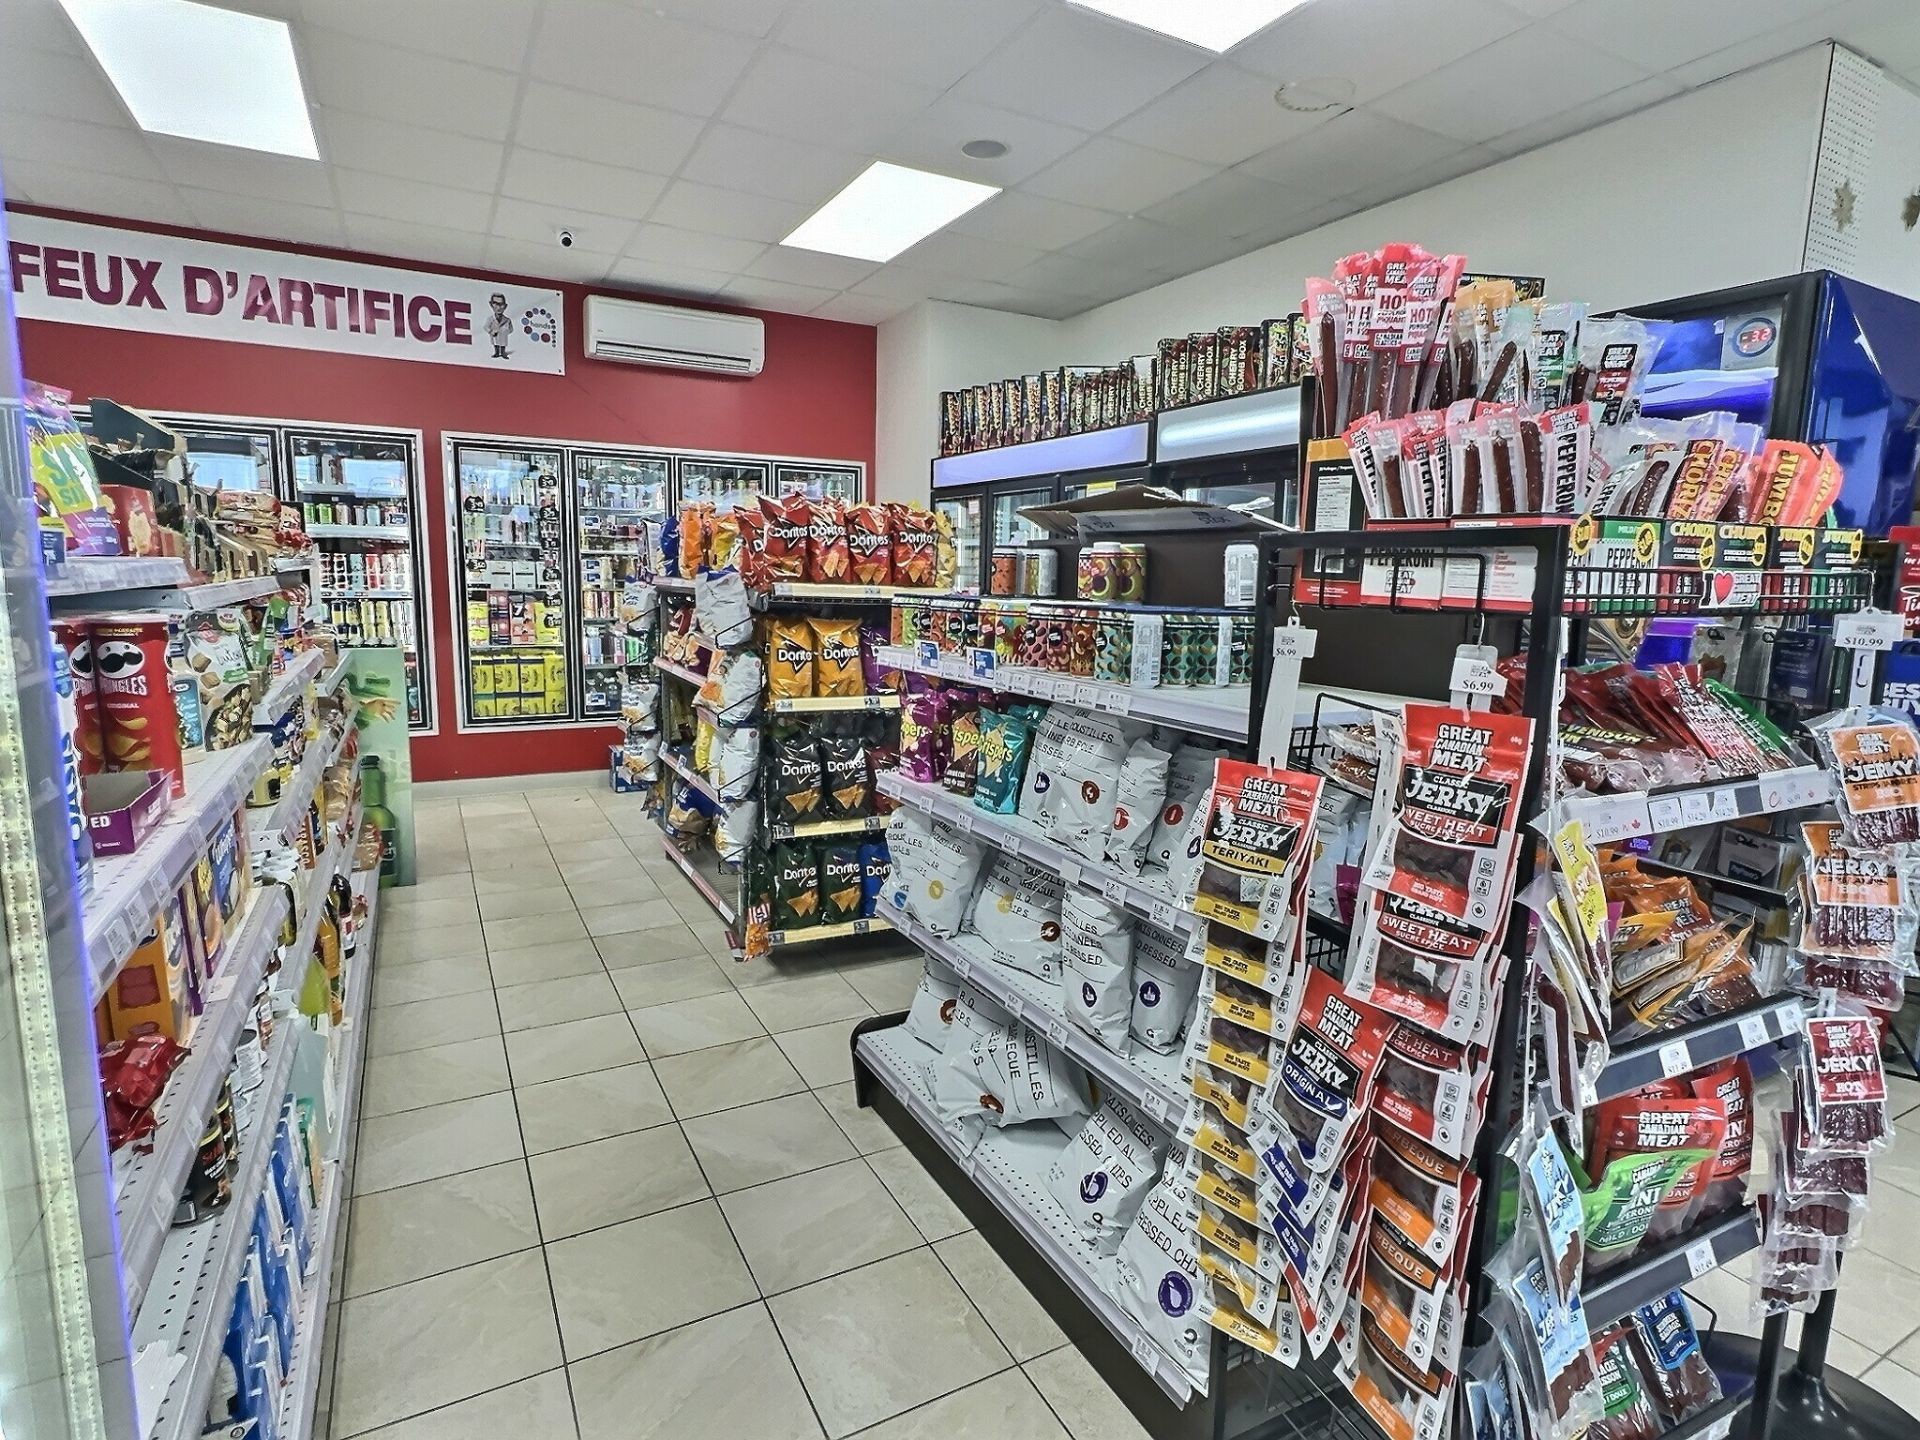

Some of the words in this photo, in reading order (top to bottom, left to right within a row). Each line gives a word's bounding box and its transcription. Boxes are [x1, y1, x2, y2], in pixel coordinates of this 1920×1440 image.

[9, 240, 167, 311] FEUX
[182, 264, 473, 345] D'ARTIFICE
[530, 320, 551, 330] hands
[1410, 308, 1434, 324] HOT
[1205, 345, 1214, 369] BOX
[1238, 339, 1247, 362] BOX
[1170, 359, 1179, 395] CHERRY
[1196, 353, 1205, 390] CHERRY
[1229, 348, 1237, 386] CHERRY
[1236, 362, 1246, 391] BOMB
[1177, 372, 1187, 400] BOMB
[1204, 367, 1214, 396] BOMB
[1107, 384, 1115, 419] CHERRY
[1556, 433, 1577, 514] PEPPERON
[850, 531, 889, 546] Doritos
[899, 531, 934, 544] Dorito
[823, 646, 860, 660] Doritos
[1276, 647, 1297, 657] $6.99
[1844, 636, 1884, 647] $10.99
[778, 648, 813, 662] Dorito
[1462, 679, 1494, 692] $6.99
[1438, 723, 1494, 746] GREAT
[1568, 723, 1643, 746] VENISON
[1434, 738, 1486, 756] CANADIAN
[1430, 749, 1488, 774] MEAT
[1849, 759, 1914, 783] JERKY
[1243, 776, 1290, 797] GREAT
[1433, 774, 1471, 789] CLASSIC
[1237, 798, 1280, 818] MEAT
[1404, 778, 1496, 816] JERKY
[1237, 817, 1269, 832] CLASSIC
[1444, 817, 1488, 838] HEAT
[1213, 822, 1287, 851] JERKY
[1211, 844, 1270, 870] TERIYAKI
[1818, 857, 1889, 877] JERKY
[1382, 916, 1427, 937] SWEET
[1428, 927, 1473, 951] HEAT
[1136, 941, 1177, 969] DRESSED
[1323, 1007, 1355, 1036] CANADIAN
[1326, 994, 1363, 1027] GREAT
[1317, 1017, 1356, 1051] MEAT
[1313, 1041, 1340, 1064] CLASSIC
[1413, 1038, 1453, 1062] HEAT
[1291, 1038, 1350, 1091] JERKY
[1817, 1054, 1874, 1074] JERKY
[1284, 1063, 1333, 1110] ORIGINAL
[1717, 1077, 1741, 1098] GREAT
[1836, 1081, 1862, 1094] HOT
[1638, 1111, 1691, 1124] GREAT
[1727, 1098, 1745, 1114] EAT
[1637, 1134, 1690, 1147] MEAT
[1638, 1123, 1687, 1135] CANADIAN
